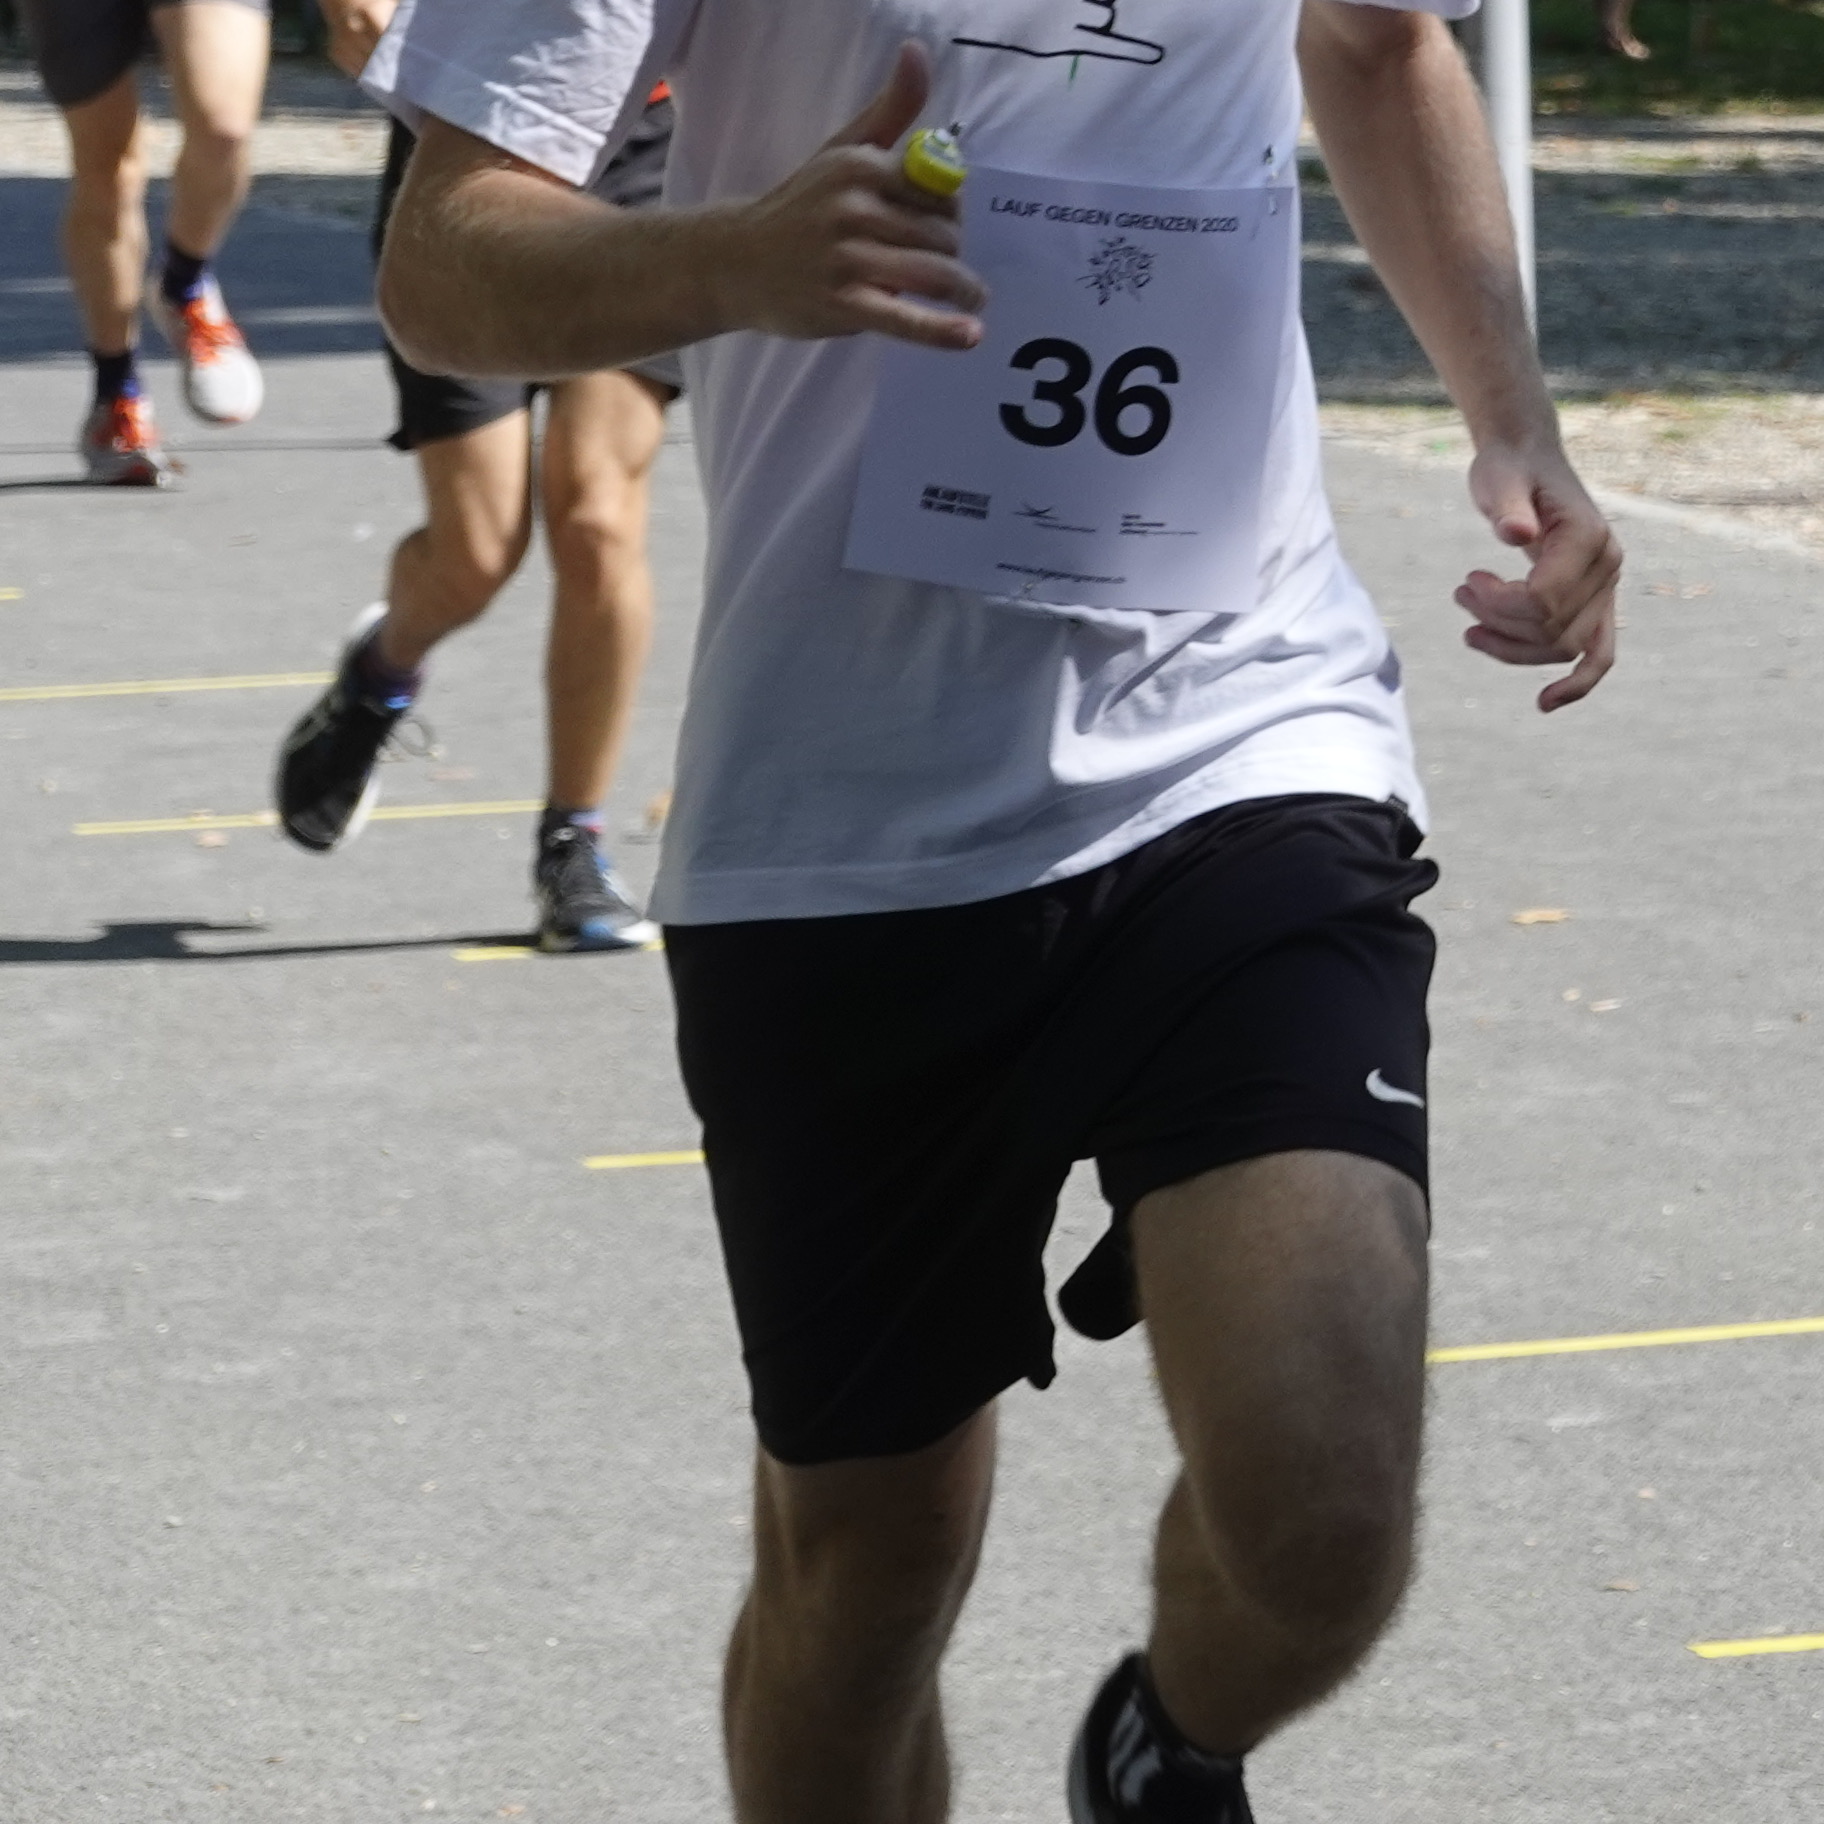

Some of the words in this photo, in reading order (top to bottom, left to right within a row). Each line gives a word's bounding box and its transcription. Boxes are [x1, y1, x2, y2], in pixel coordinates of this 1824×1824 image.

[990, 195, 1042, 217] LAUF
[1044, 204, 1113, 226] GEGEN
[1114, 212, 1200, 233] GRENZEN
[1201, 216, 1240, 233] 2020
[998, 337, 1180, 456] 36
